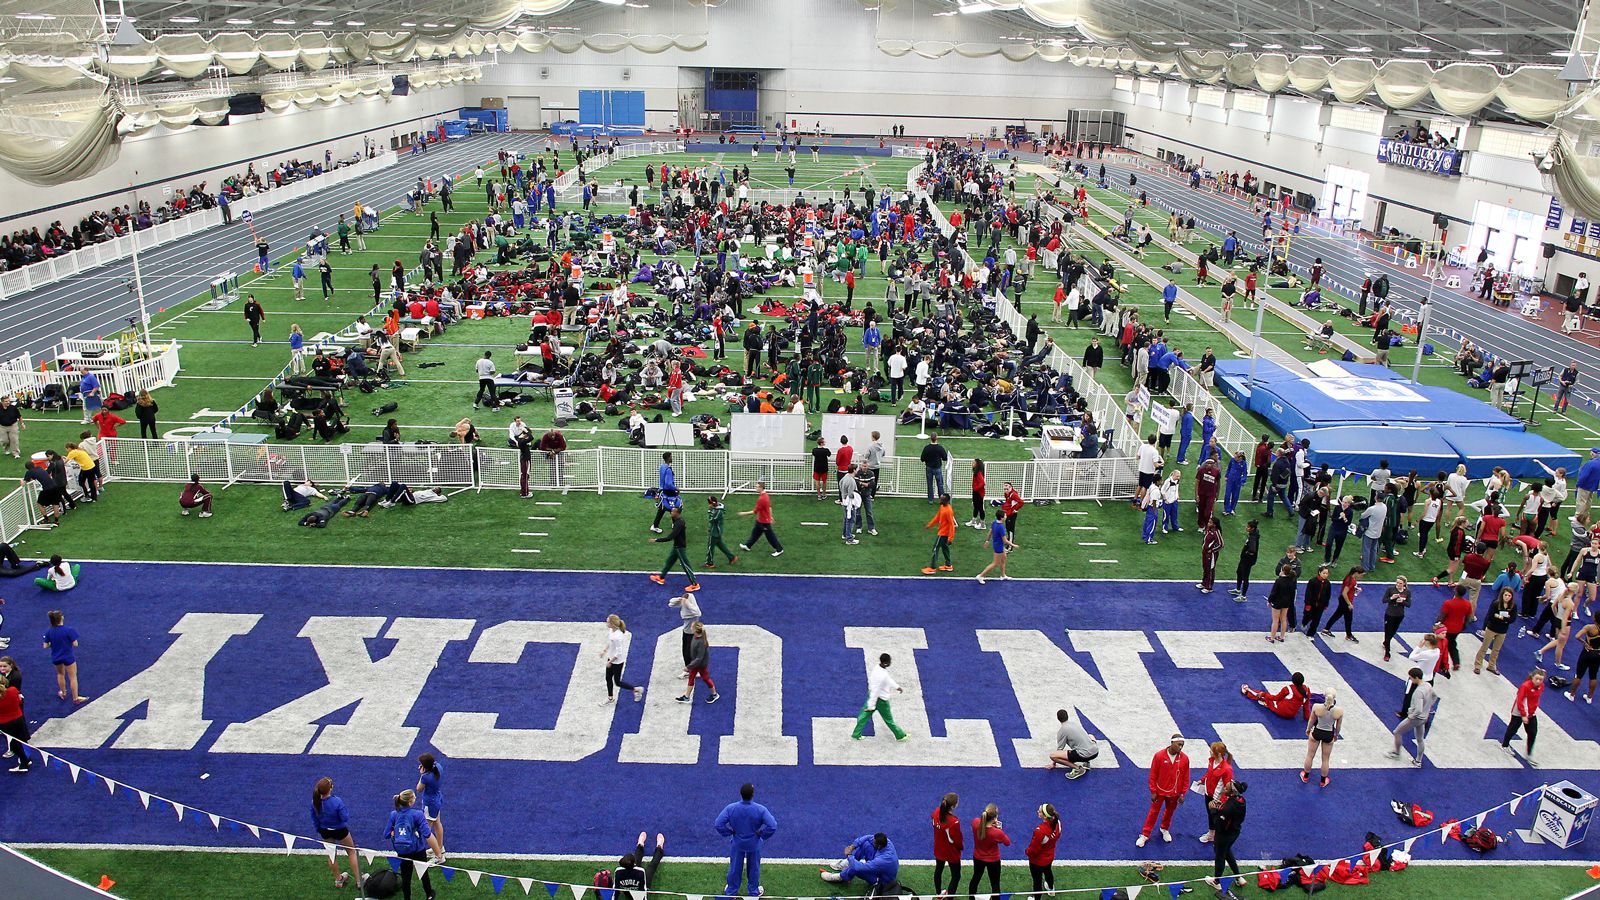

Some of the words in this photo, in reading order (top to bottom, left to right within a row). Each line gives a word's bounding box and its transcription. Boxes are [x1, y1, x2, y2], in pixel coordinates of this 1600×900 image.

[1387, 141, 1444, 161] KENTUCKY
[1391, 153, 1435, 171] WILDCATS
[28, 612, 1600, 770] KENTUCKY
[1545, 790, 1577, 812] WILDCATS
